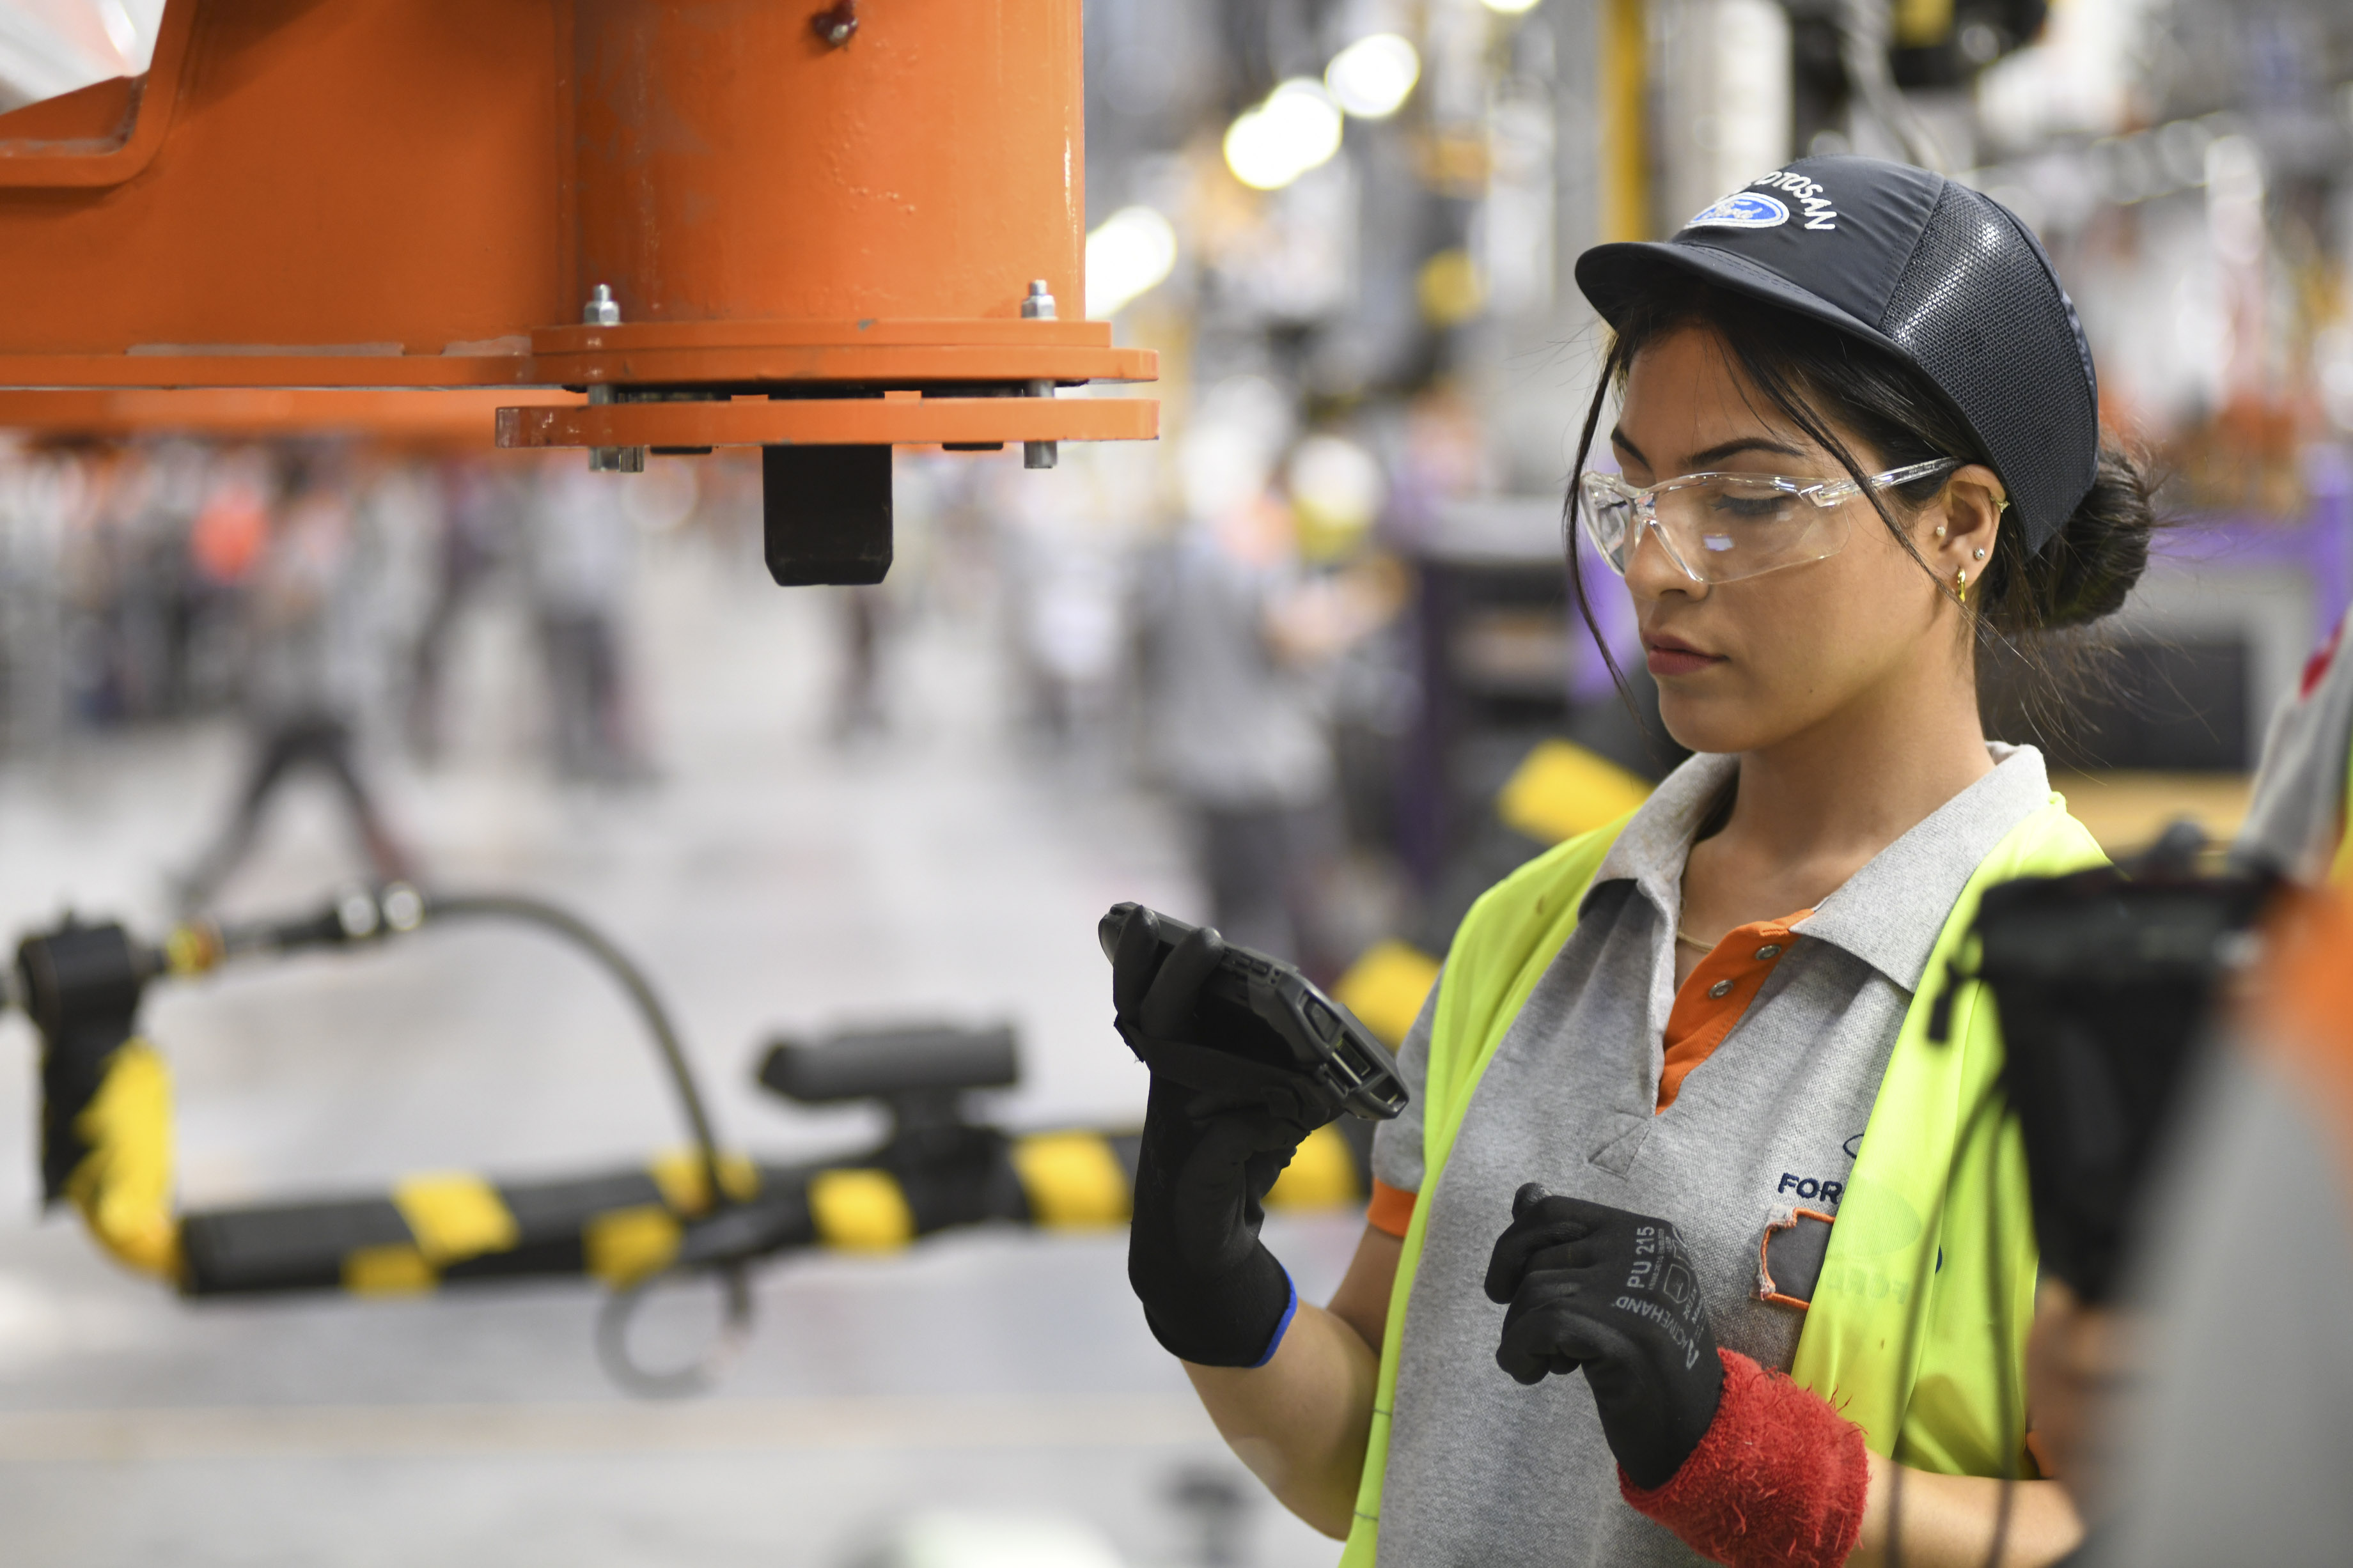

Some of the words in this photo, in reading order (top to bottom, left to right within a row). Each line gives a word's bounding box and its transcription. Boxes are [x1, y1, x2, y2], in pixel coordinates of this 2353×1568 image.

[1754, 171, 1837, 229] OTOSAN
[1636, 1226, 1655, 1255] 215
[1627, 1261, 1652, 1289] PU
[1616, 1296, 1689, 1351] ACTIVEHAND
